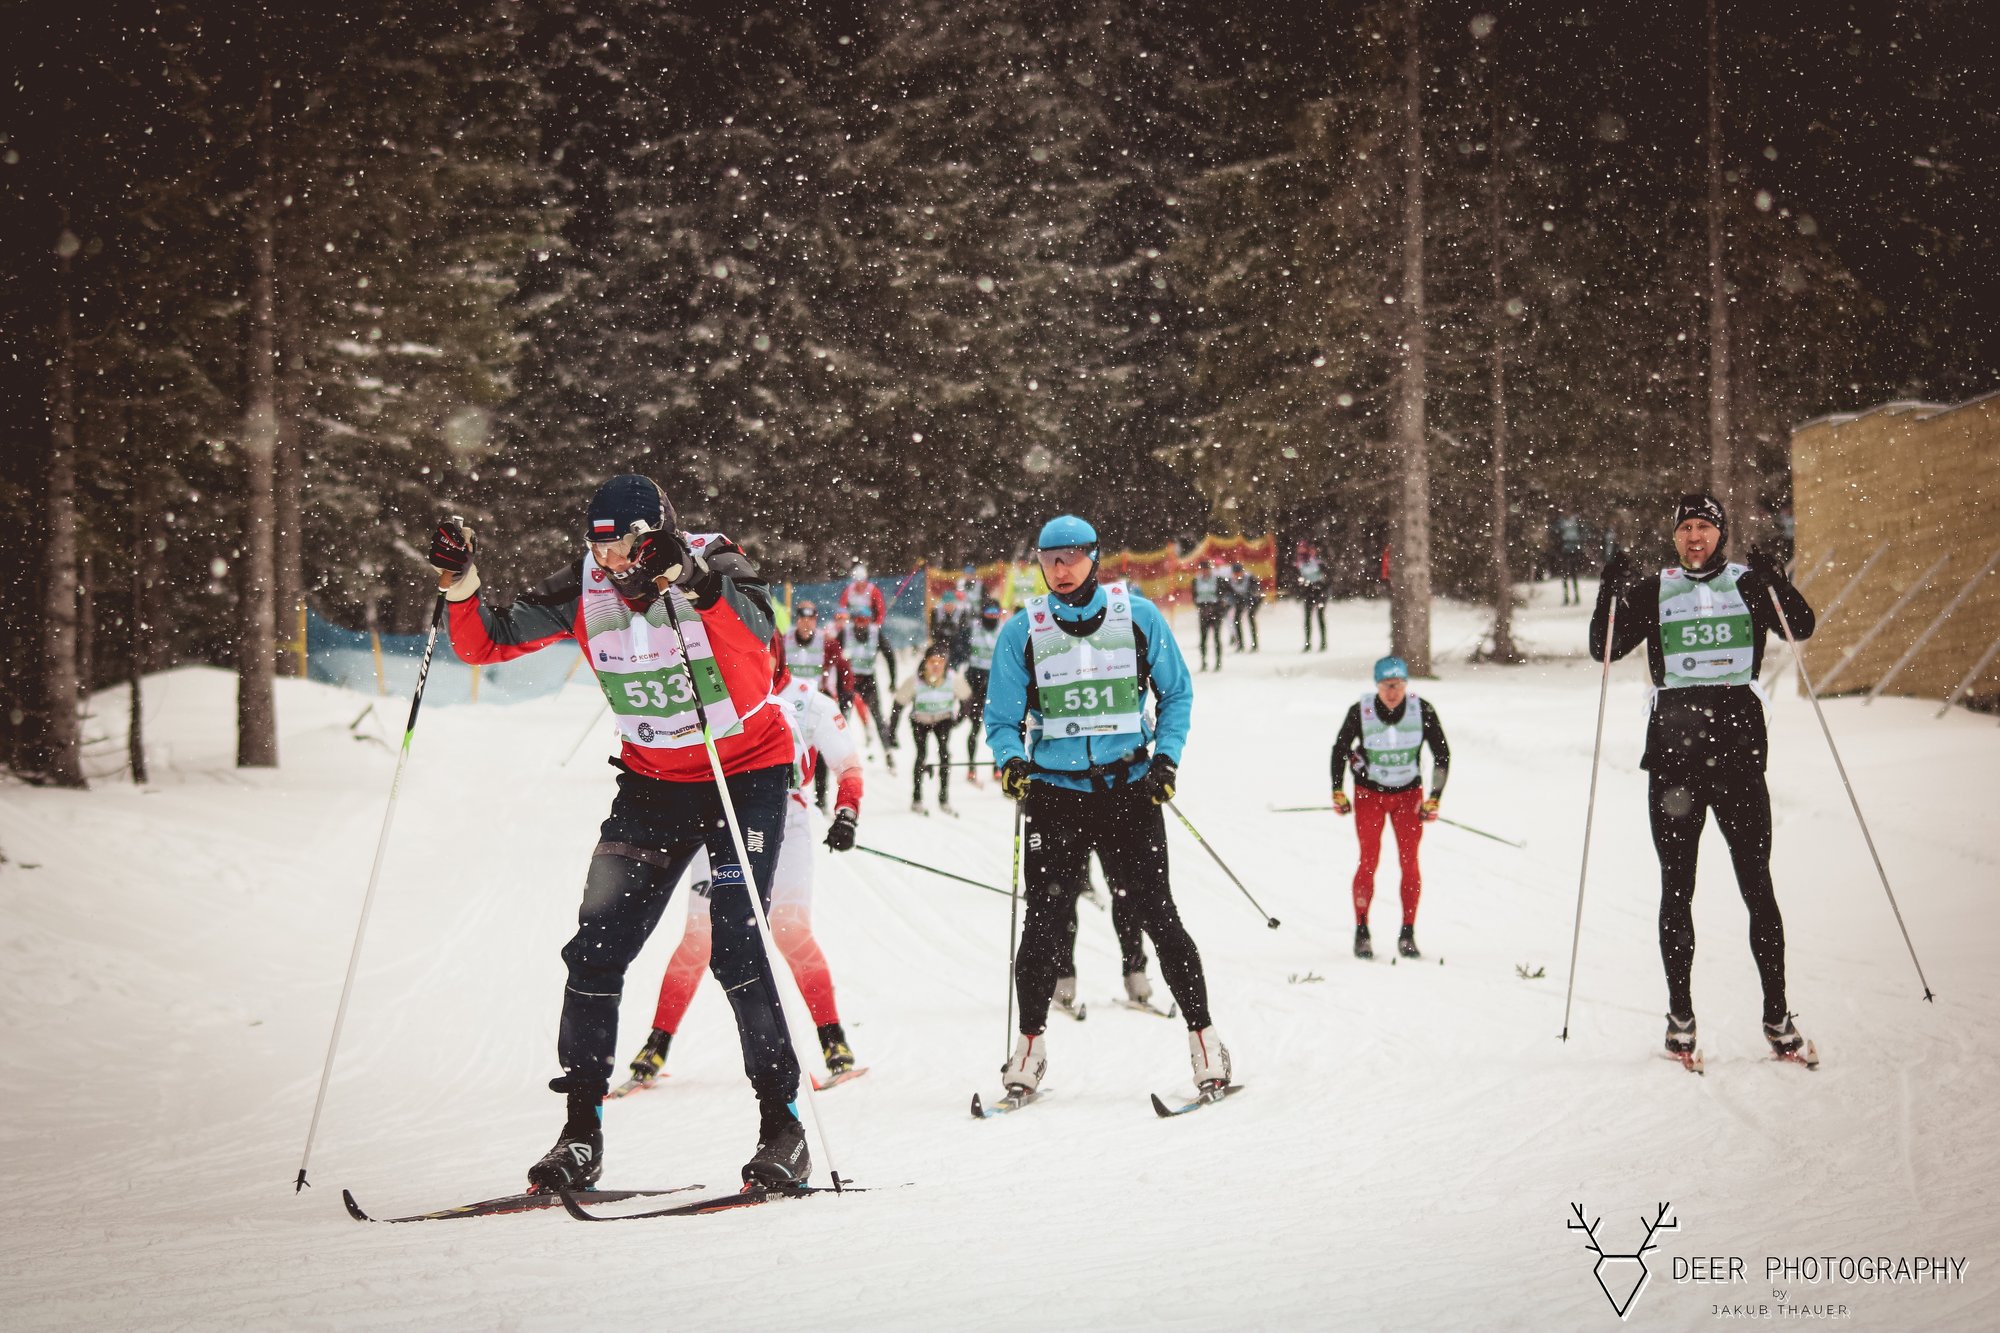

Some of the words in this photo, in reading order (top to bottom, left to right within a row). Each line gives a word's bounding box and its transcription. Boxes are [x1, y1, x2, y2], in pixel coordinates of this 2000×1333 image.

[1682, 623, 1733, 647] 538
[623, 674, 694, 709] 533
[1064, 686, 1115, 710] 531
